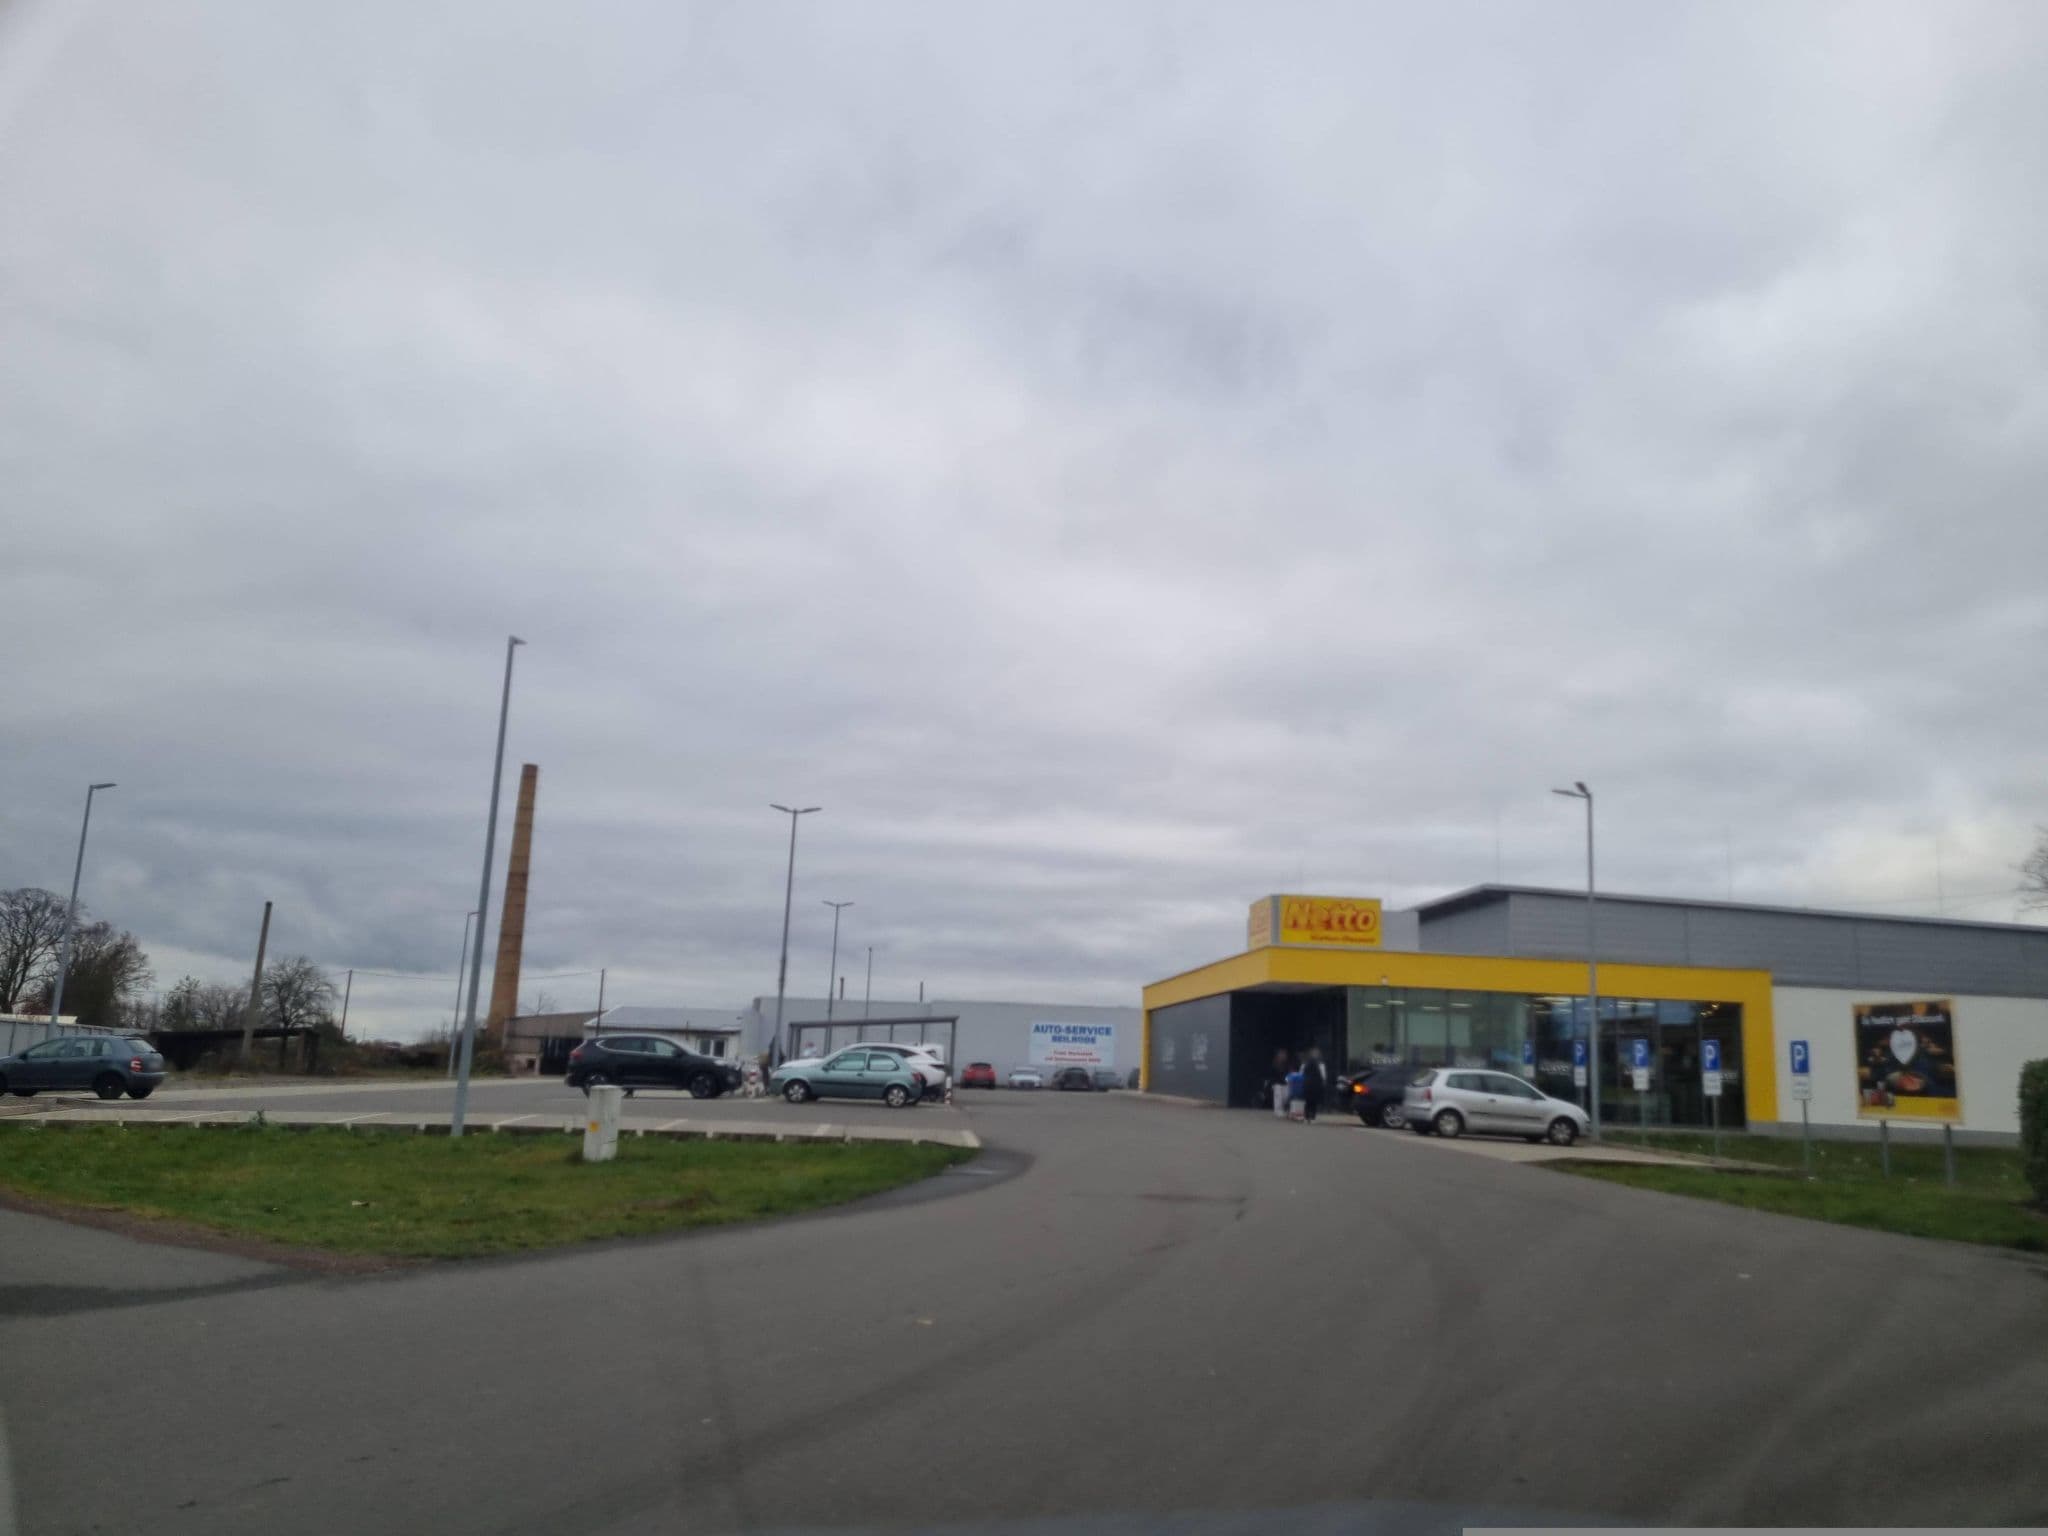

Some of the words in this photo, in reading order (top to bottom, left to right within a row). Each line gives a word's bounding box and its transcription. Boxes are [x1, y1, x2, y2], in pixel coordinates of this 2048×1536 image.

[1033, 1024, 1113, 1036] AUTO-SERVICE
[1633, 1044, 1643, 1065] P
[1704, 1044, 1716, 1069] P
[1793, 1044, 1805, 1072] P
